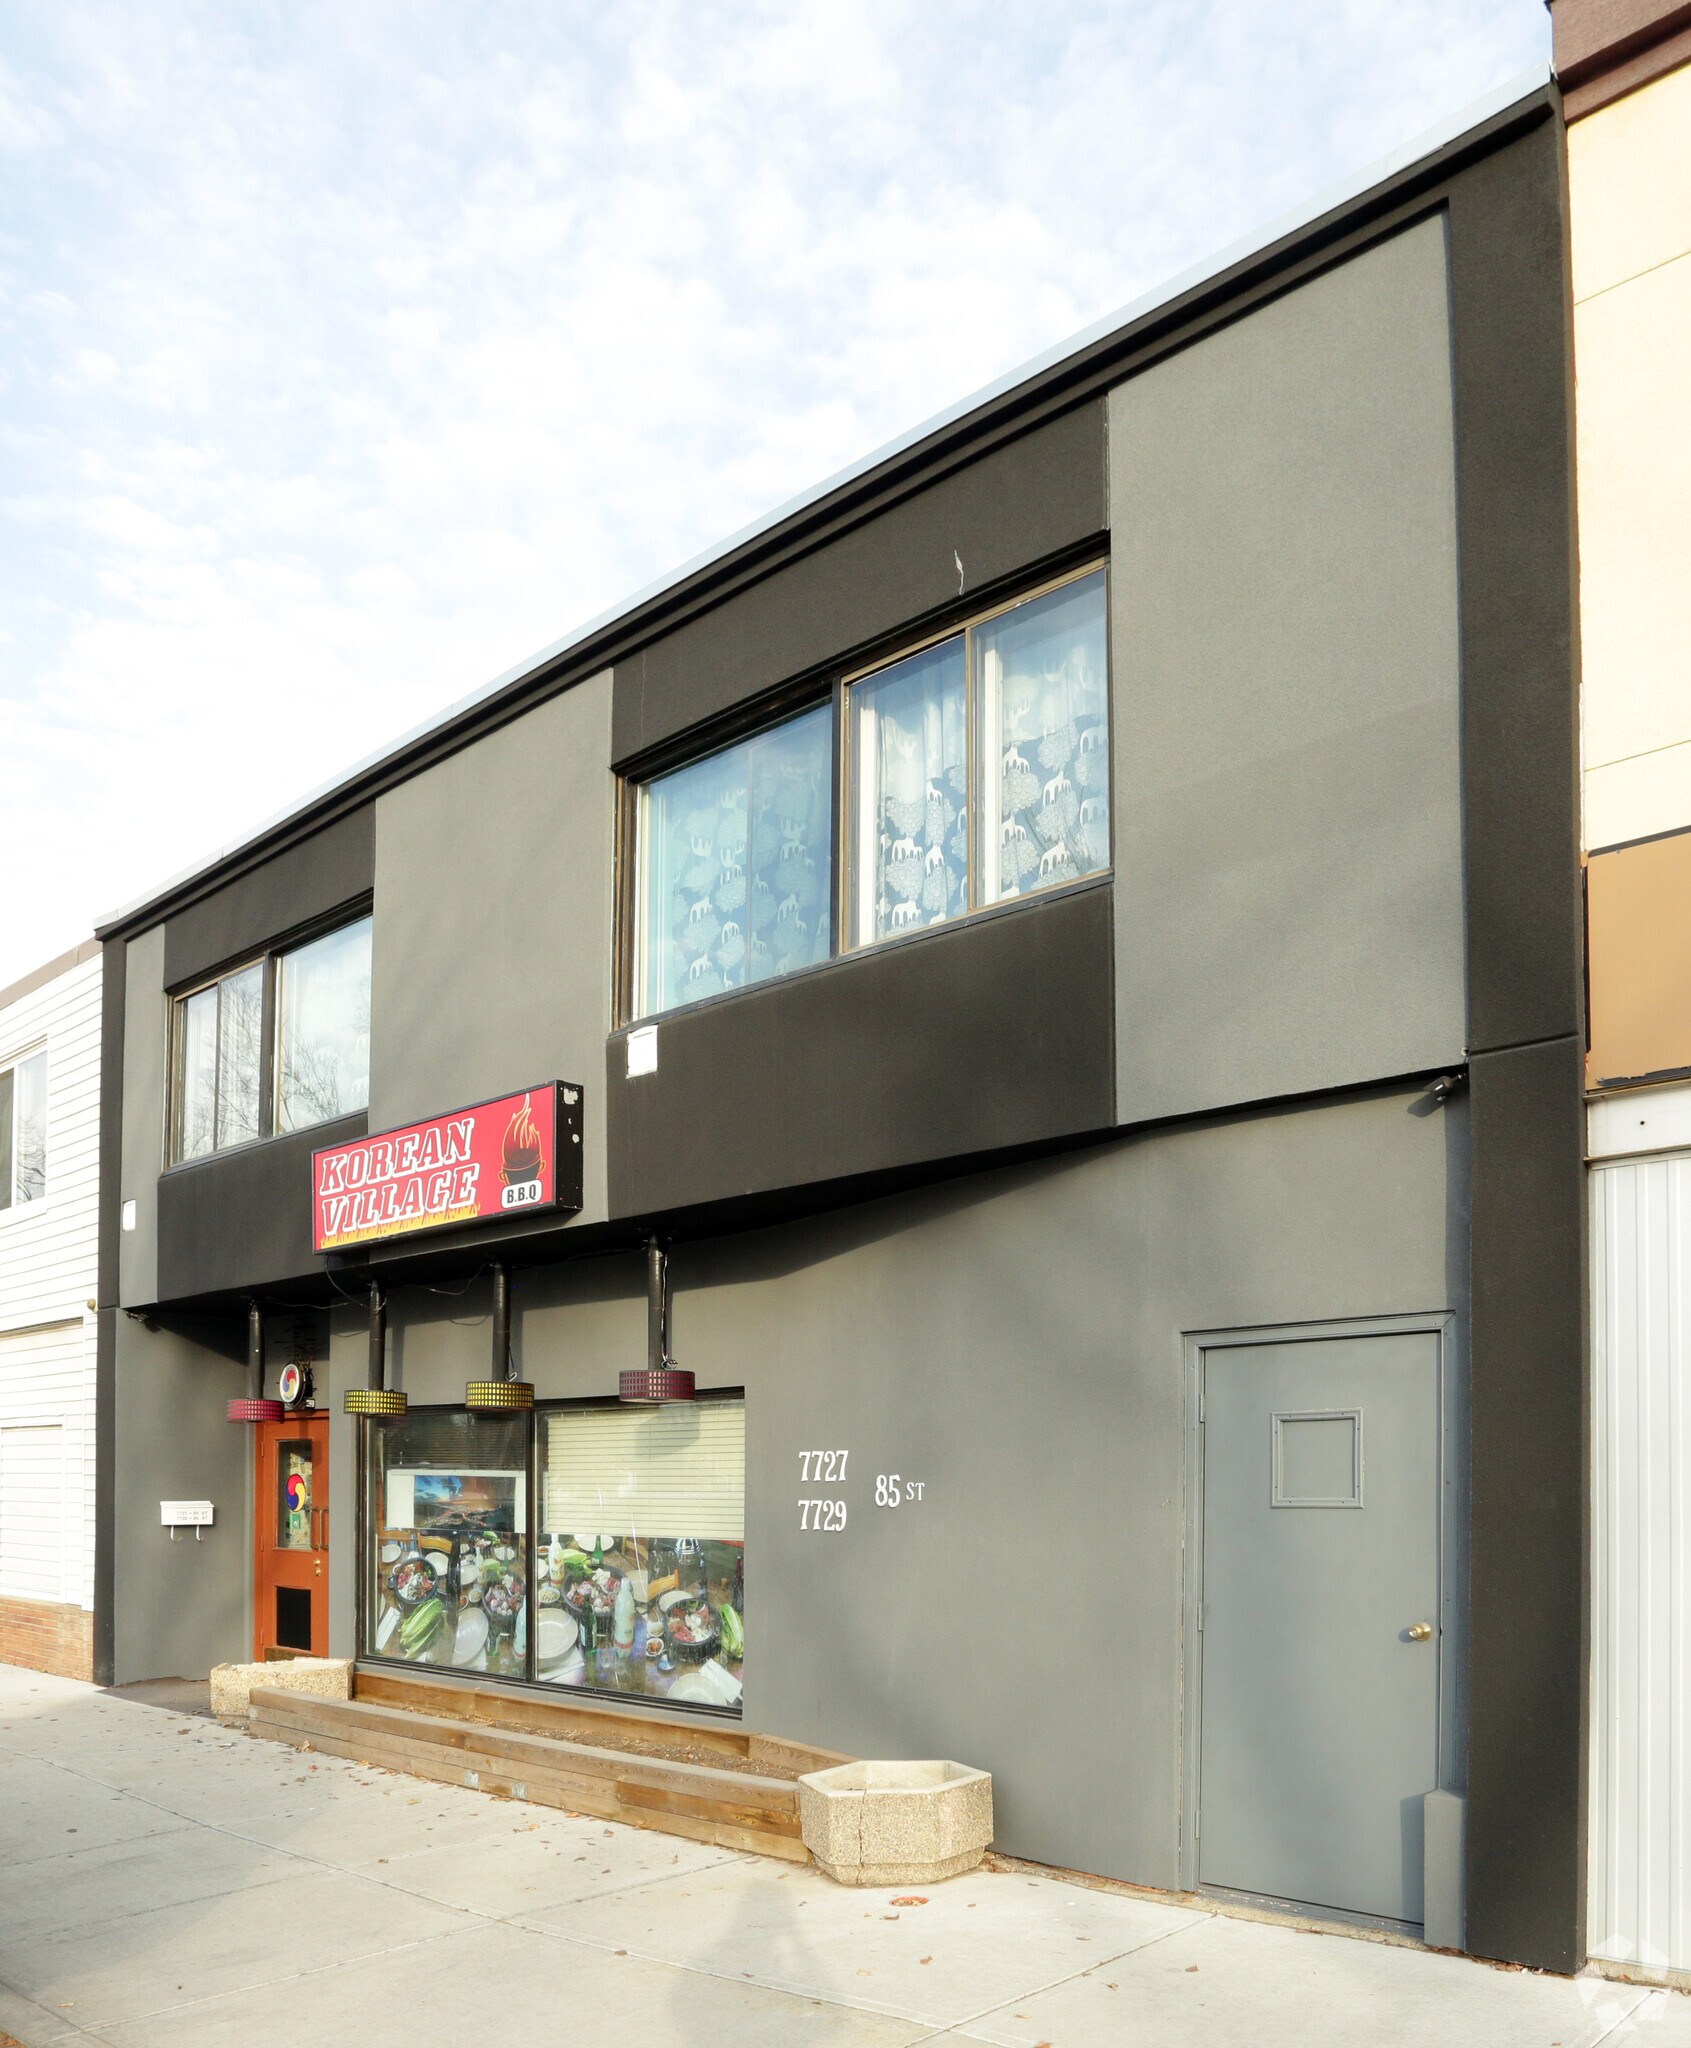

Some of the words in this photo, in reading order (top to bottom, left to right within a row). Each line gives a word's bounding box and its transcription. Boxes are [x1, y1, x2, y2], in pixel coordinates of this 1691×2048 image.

[319, 1117, 475, 1195] KOREAN
[321, 1163, 480, 1236] VILLAGE
[507, 1184, 536, 1203] B.B.Q
[798, 1450, 849, 1481] 7727
[875, 1474, 901, 1507] 85
[905, 1482, 925, 1500] ST
[798, 1500, 847, 1531] 7729
